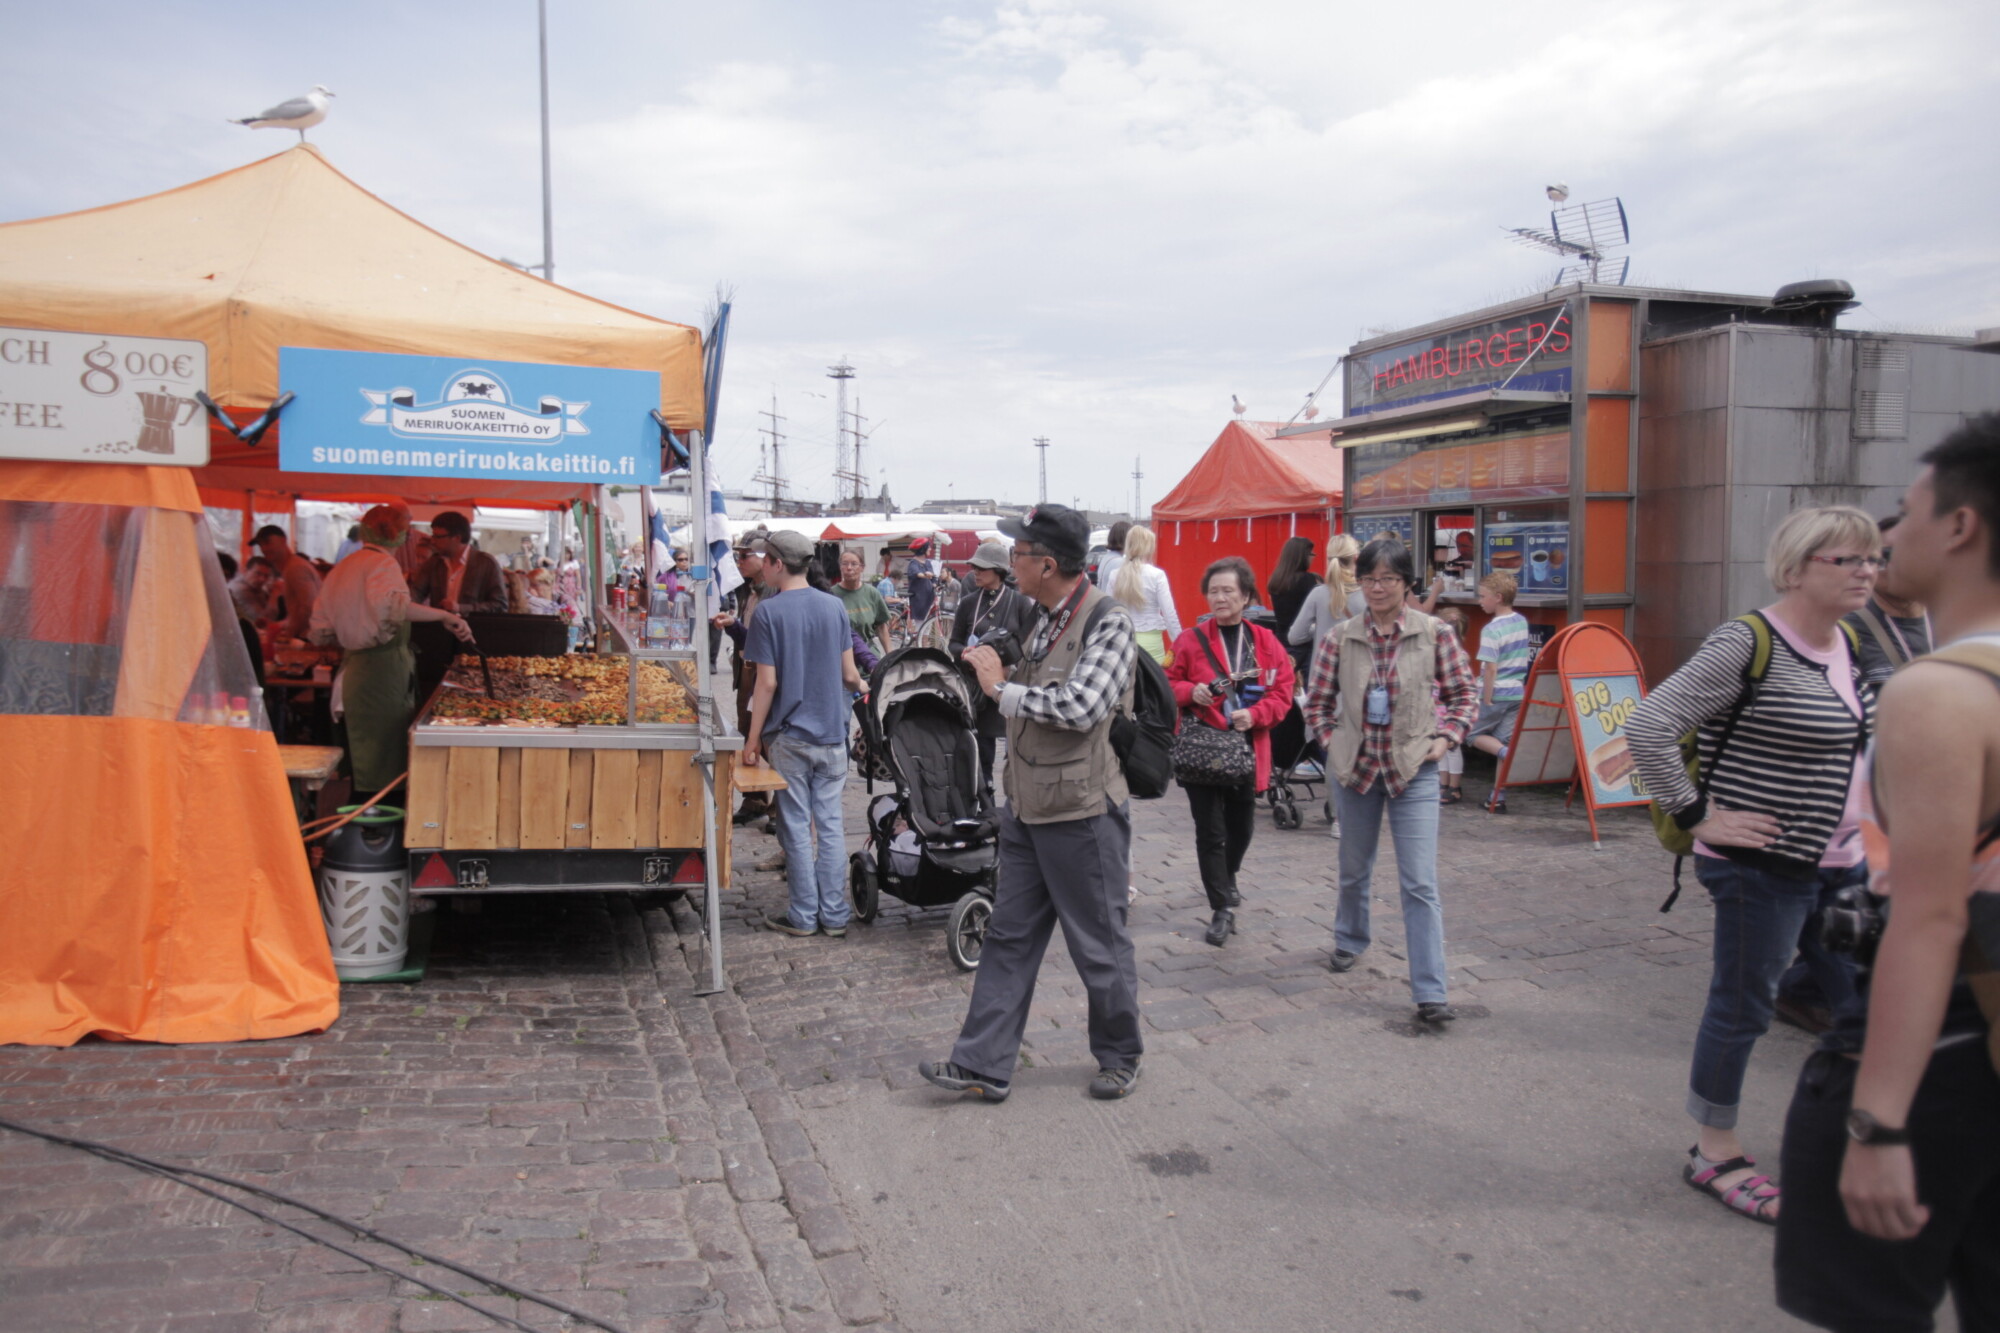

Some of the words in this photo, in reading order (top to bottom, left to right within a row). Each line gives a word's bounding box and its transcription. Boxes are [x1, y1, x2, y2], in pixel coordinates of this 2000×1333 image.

[0, 338, 51, 365] CH
[1374, 317, 1571, 391] HAMBURGERS
[404, 419, 530, 434] MERIRUOKAKEITTIÖ
[533, 425, 550, 435] OY
[451, 409, 505, 420] SUOMEN
[312, 446, 636, 476] suomenmeriruokakeittio.fi
[1058, 610, 1070, 628] EOS
[1575, 681, 1610, 717] BIG
[1598, 697, 1638, 735] DOG
